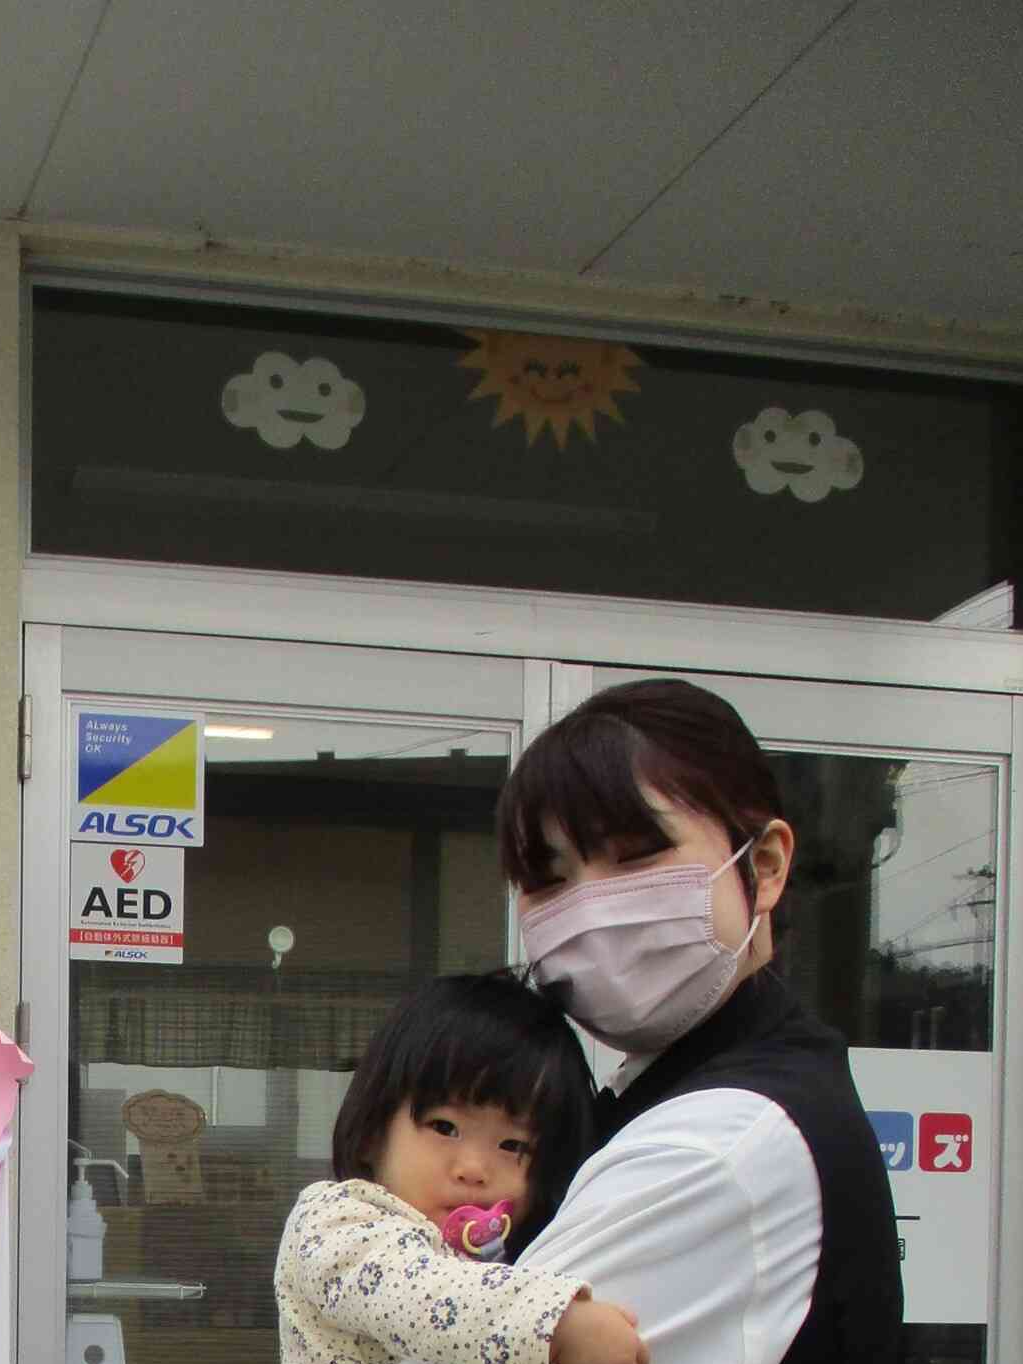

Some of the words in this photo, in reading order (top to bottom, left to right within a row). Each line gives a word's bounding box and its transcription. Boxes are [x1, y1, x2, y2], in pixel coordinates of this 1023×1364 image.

[85, 732, 131, 746] Security
[85, 744, 102, 753] OK
[79, 811, 194, 839] ALSOK
[81, 886, 172, 920] AED
[114, 950, 148, 959] ALSOK
